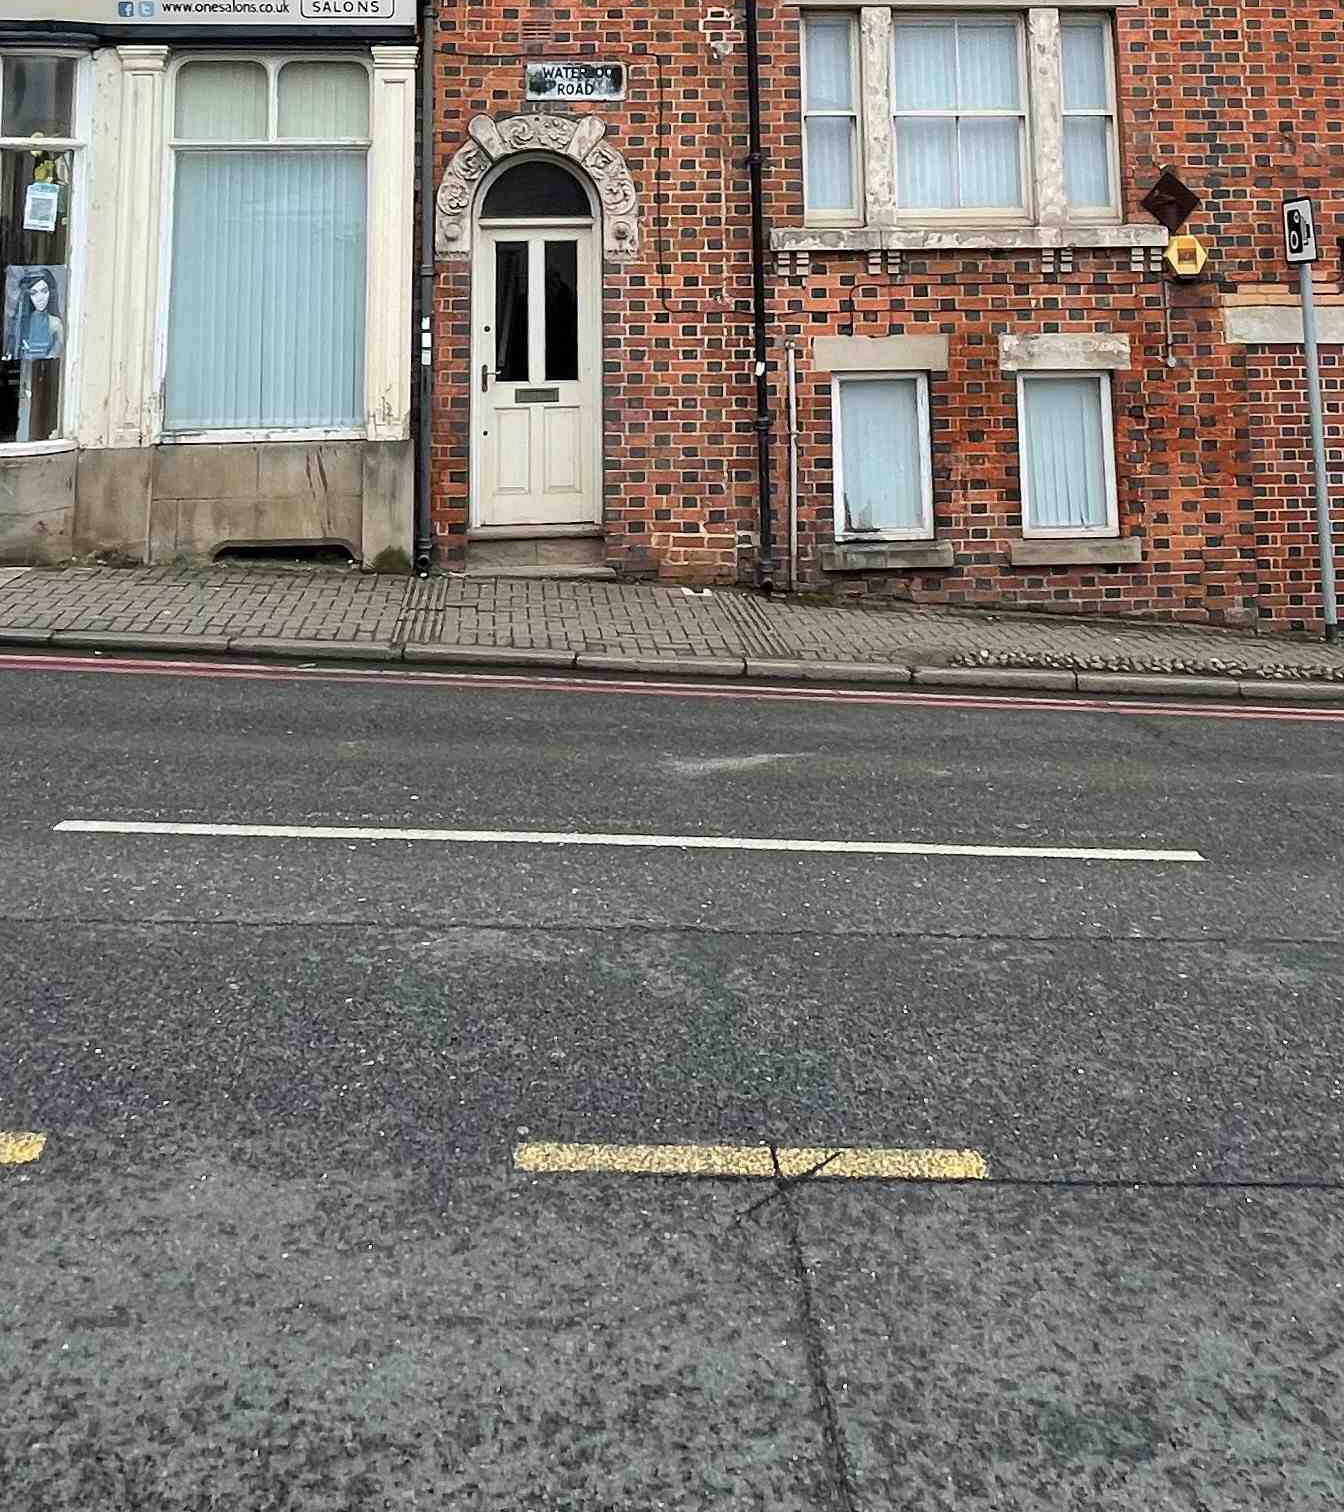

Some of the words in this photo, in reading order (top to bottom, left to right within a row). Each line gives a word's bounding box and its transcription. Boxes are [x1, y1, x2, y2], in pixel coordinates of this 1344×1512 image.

[162, 0, 290, 14] www.onesalons.co.uk
[312, 0, 380, 14] SALONS
[557, 82, 594, 96] ROAD
